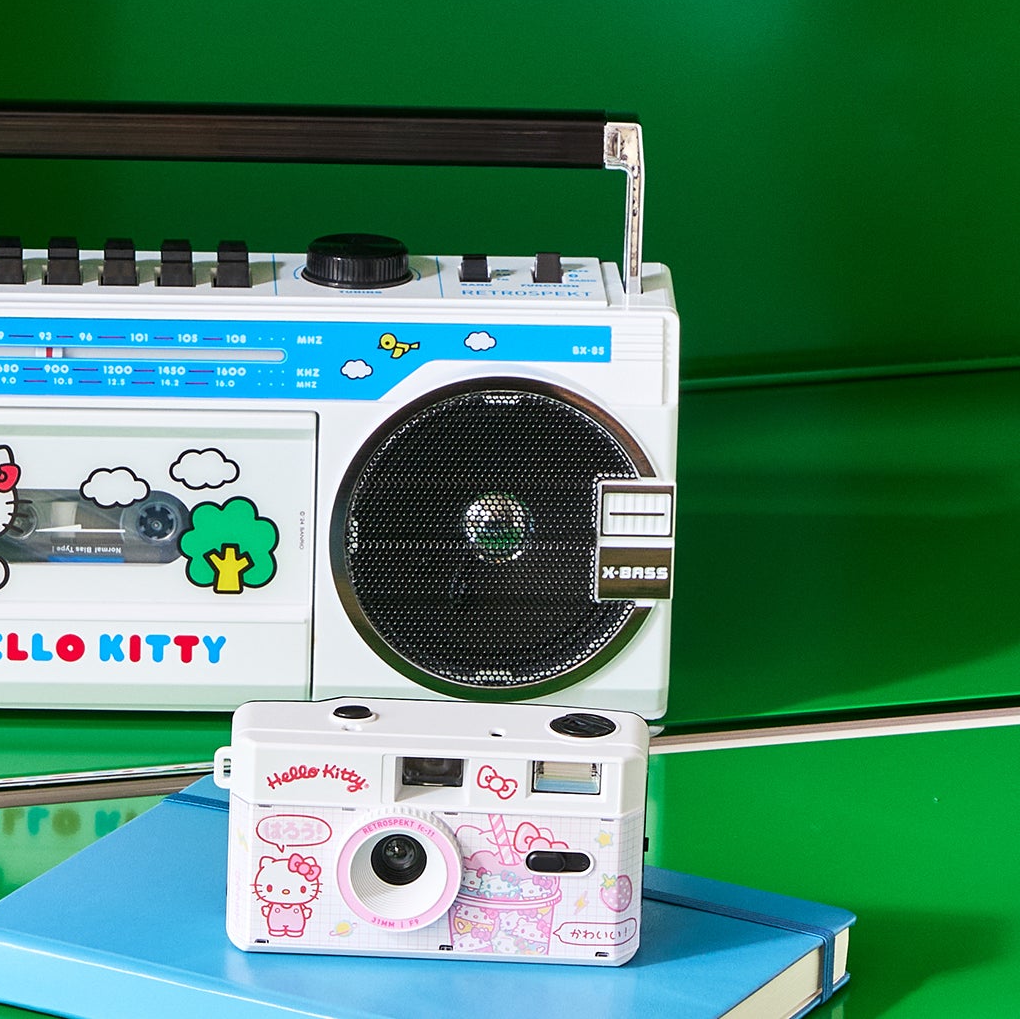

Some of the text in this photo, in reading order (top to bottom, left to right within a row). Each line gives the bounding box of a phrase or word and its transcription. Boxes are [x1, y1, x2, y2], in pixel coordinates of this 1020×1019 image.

[38, 332, 52, 340] 93
[79, 332, 93, 341] 96
[130, 333, 149, 342] 101
[177, 334, 198, 343] 105
[226, 334, 247, 343] 108
[296, 336, 323, 345] MHZ
[44, 364, 69, 373] 900
[103, 365, 132, 374] 1200
[158, 366, 186, 375] 1450
[216, 367, 247, 376] 1600
[296, 368, 320, 377] KHZ
[108, 378, 125, 386] 12.5
[56, 545, 75, 553] Type
[94, 546, 122, 554] Normal
[99, 633, 226, 664] KITTY
[267, 765, 320, 790] Hello
[362, 819, 415, 835] RETROSPEKT
